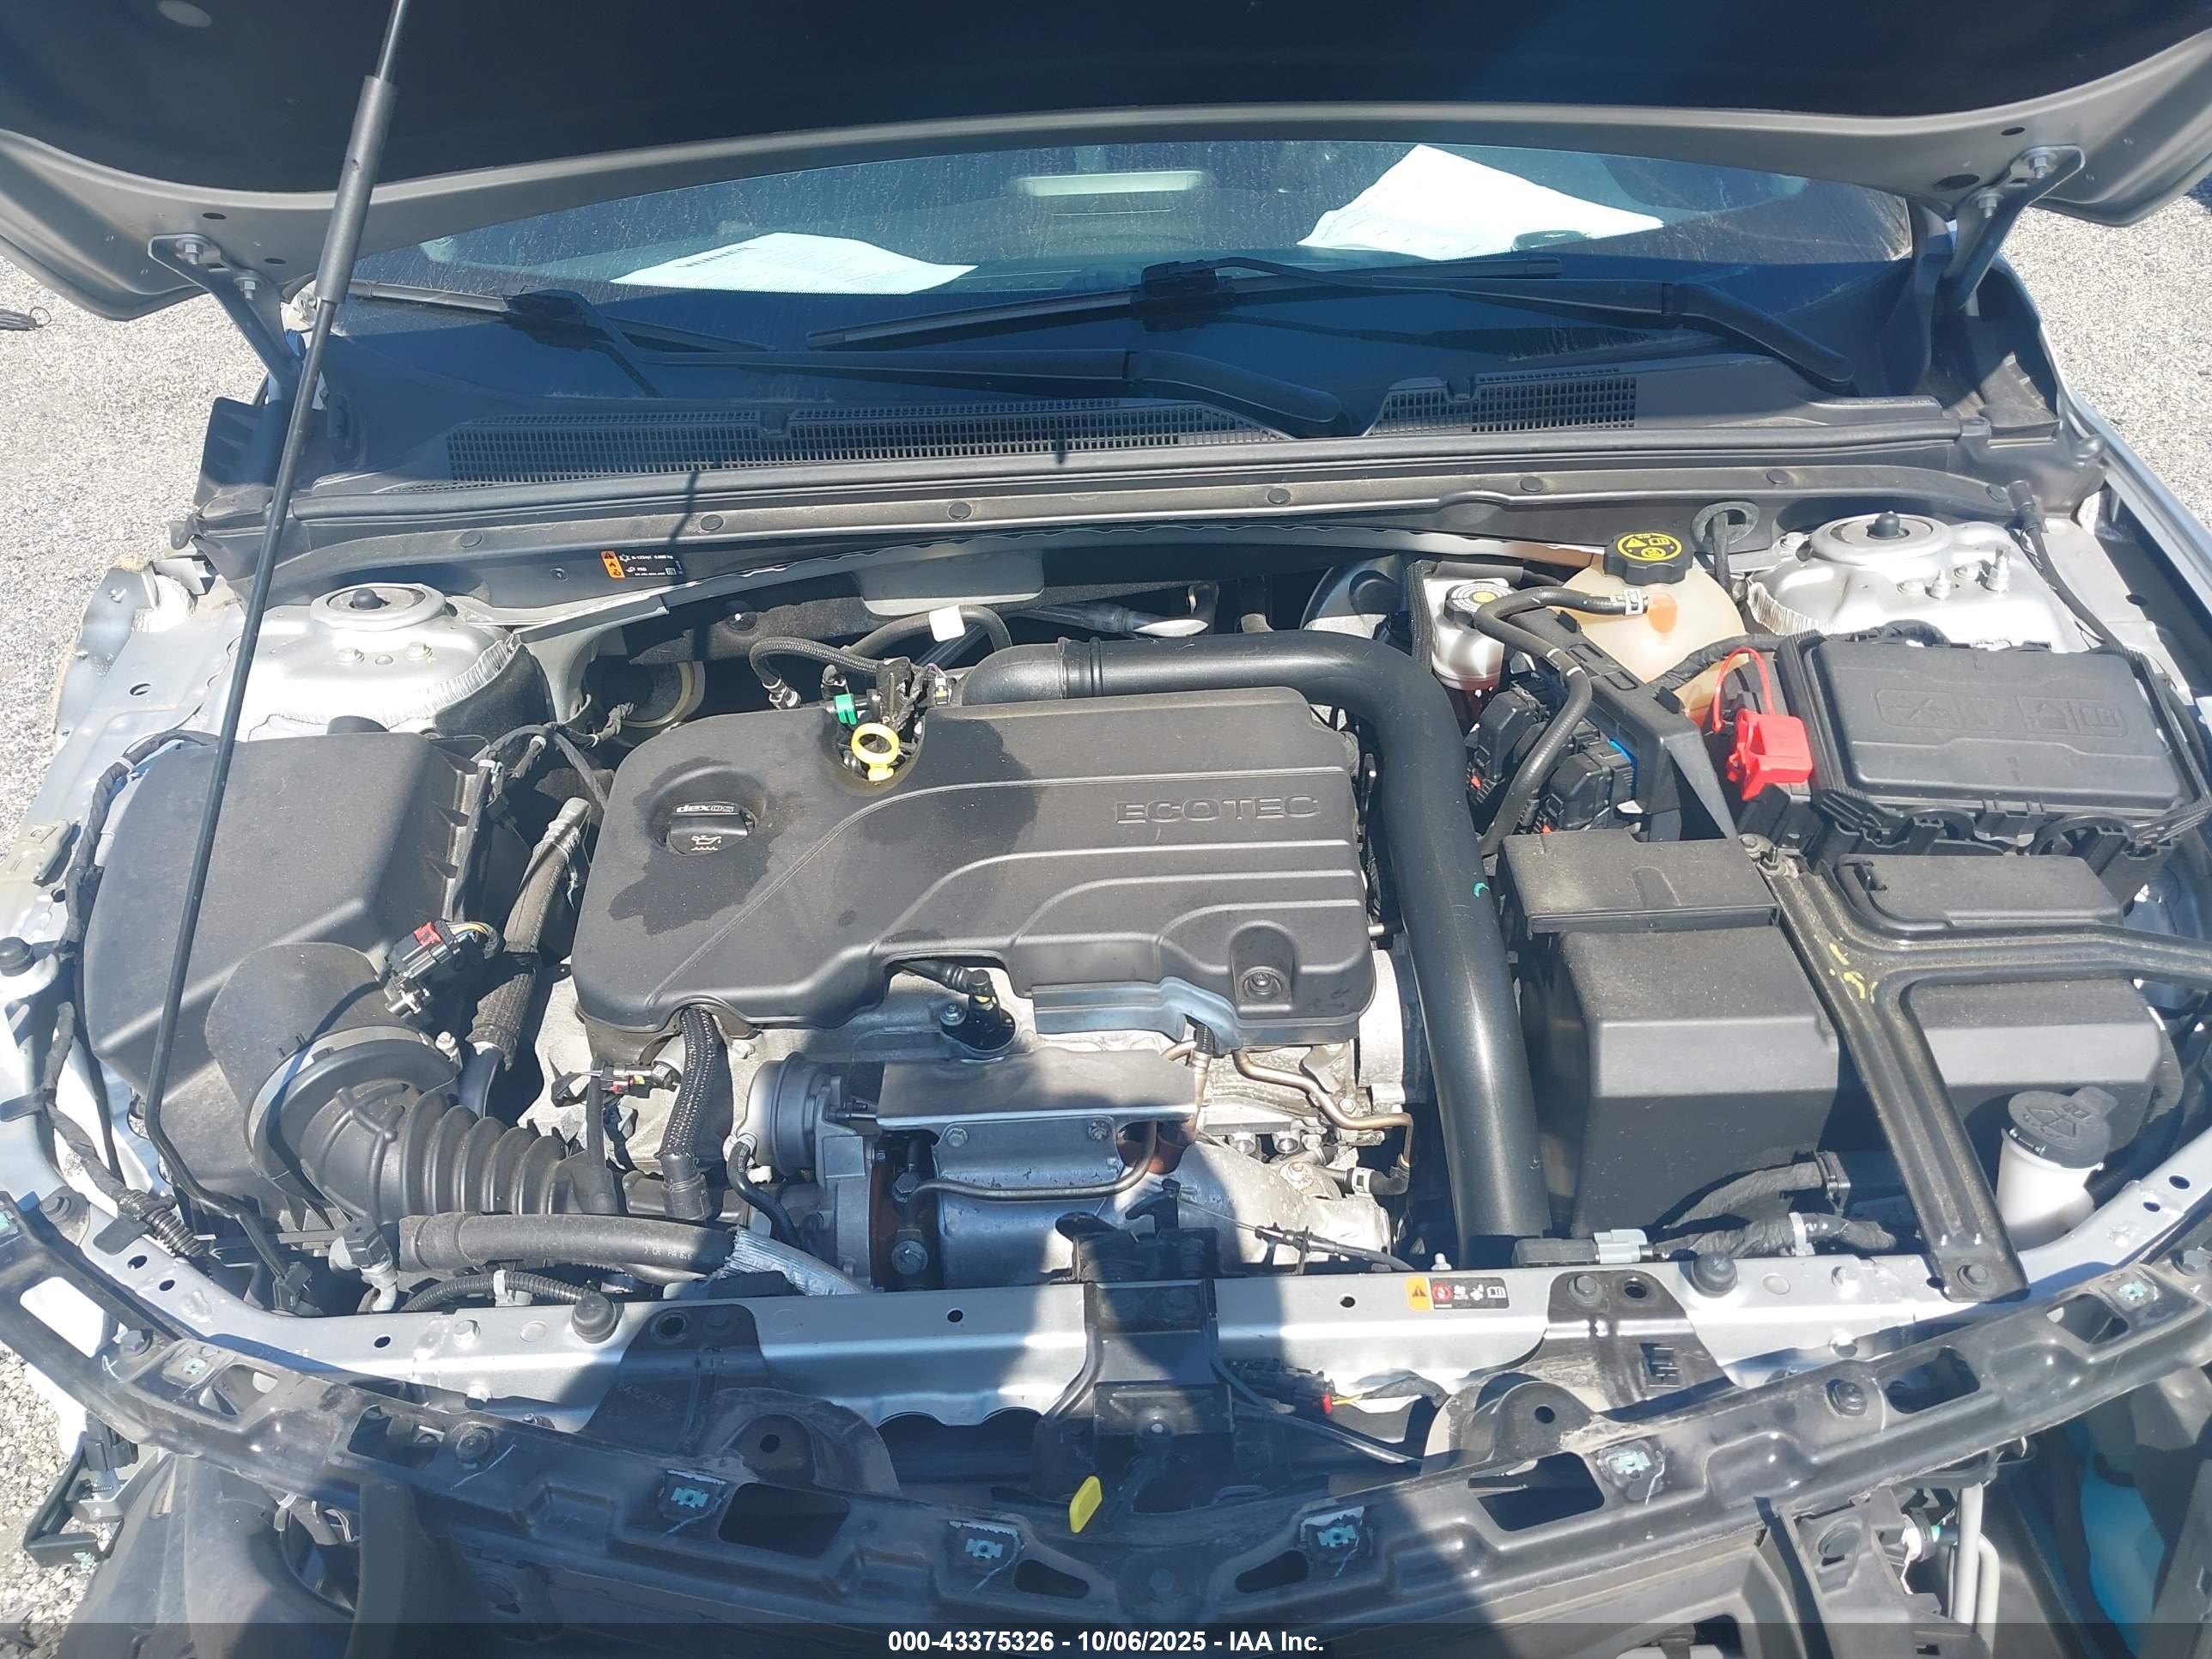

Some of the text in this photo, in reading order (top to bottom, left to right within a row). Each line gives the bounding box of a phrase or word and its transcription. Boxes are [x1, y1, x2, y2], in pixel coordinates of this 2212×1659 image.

[673, 246, 757, 269] WINNER
[676, 804, 735, 813] dexos
[1115, 793, 1321, 824] ECOTEC
